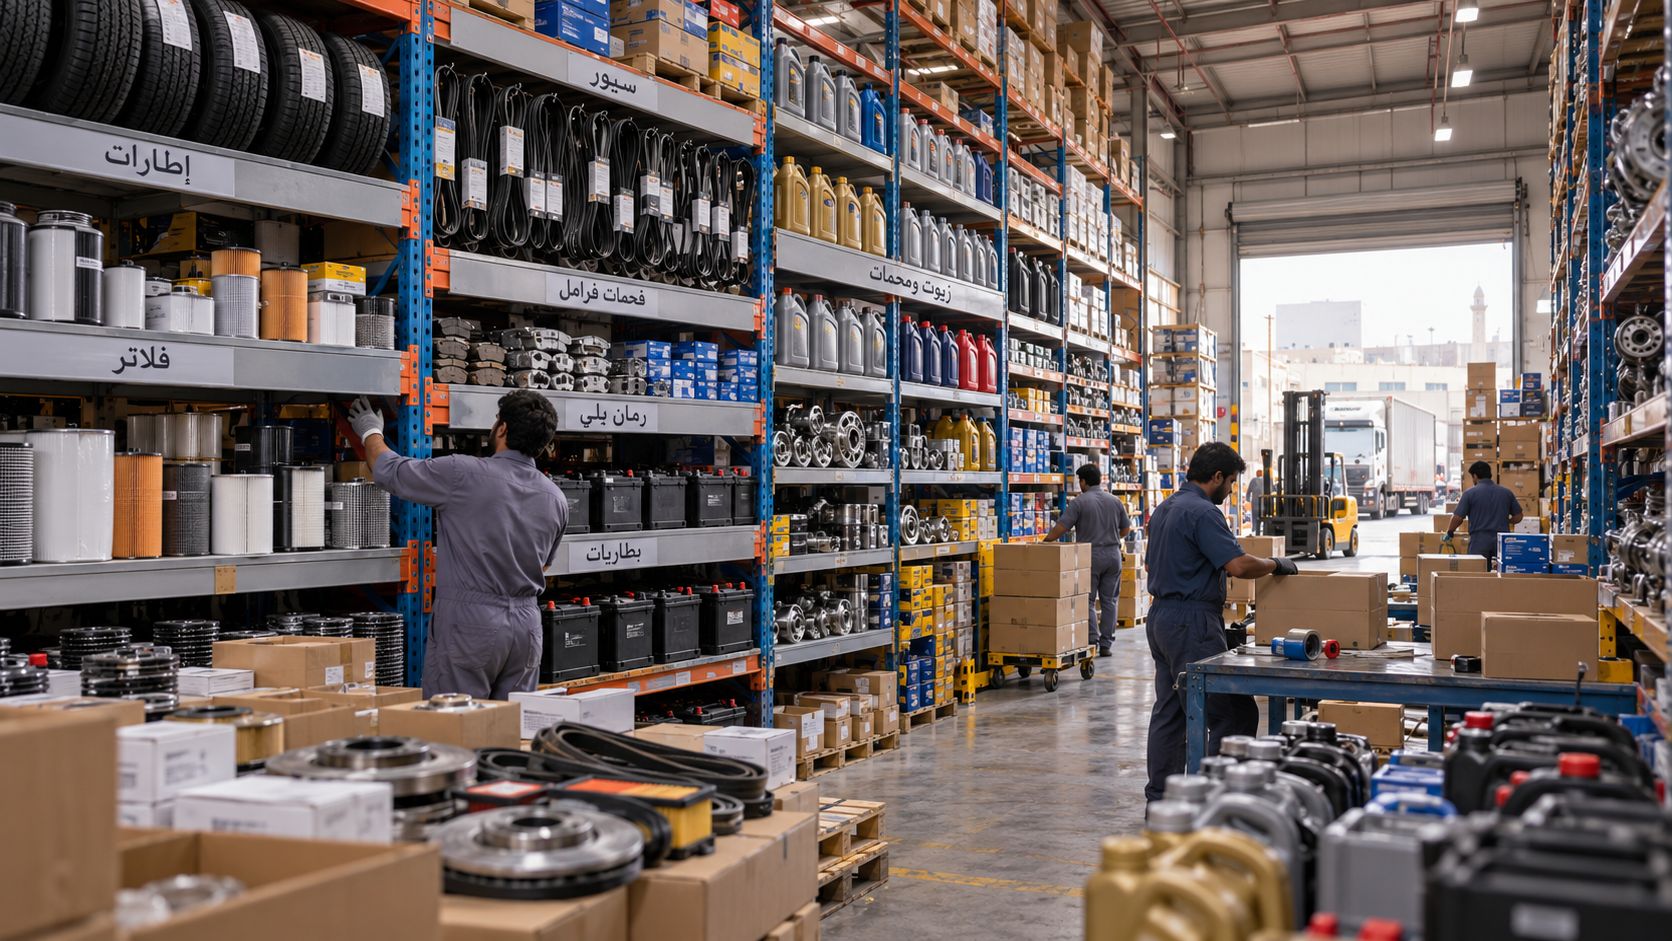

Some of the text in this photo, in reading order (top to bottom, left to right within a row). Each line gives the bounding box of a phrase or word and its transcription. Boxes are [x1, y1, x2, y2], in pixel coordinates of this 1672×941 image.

[588, 71, 637, 94] سيور
[104, 143, 191, 186] إطارات
[559, 278, 646, 306] فحمات فرامل
[921, 280, 952, 304] زيوت
[112, 345, 170, 375] فلاتر
[612, 404, 647, 428] رمان
[586, 542, 642, 566] بطاريات
